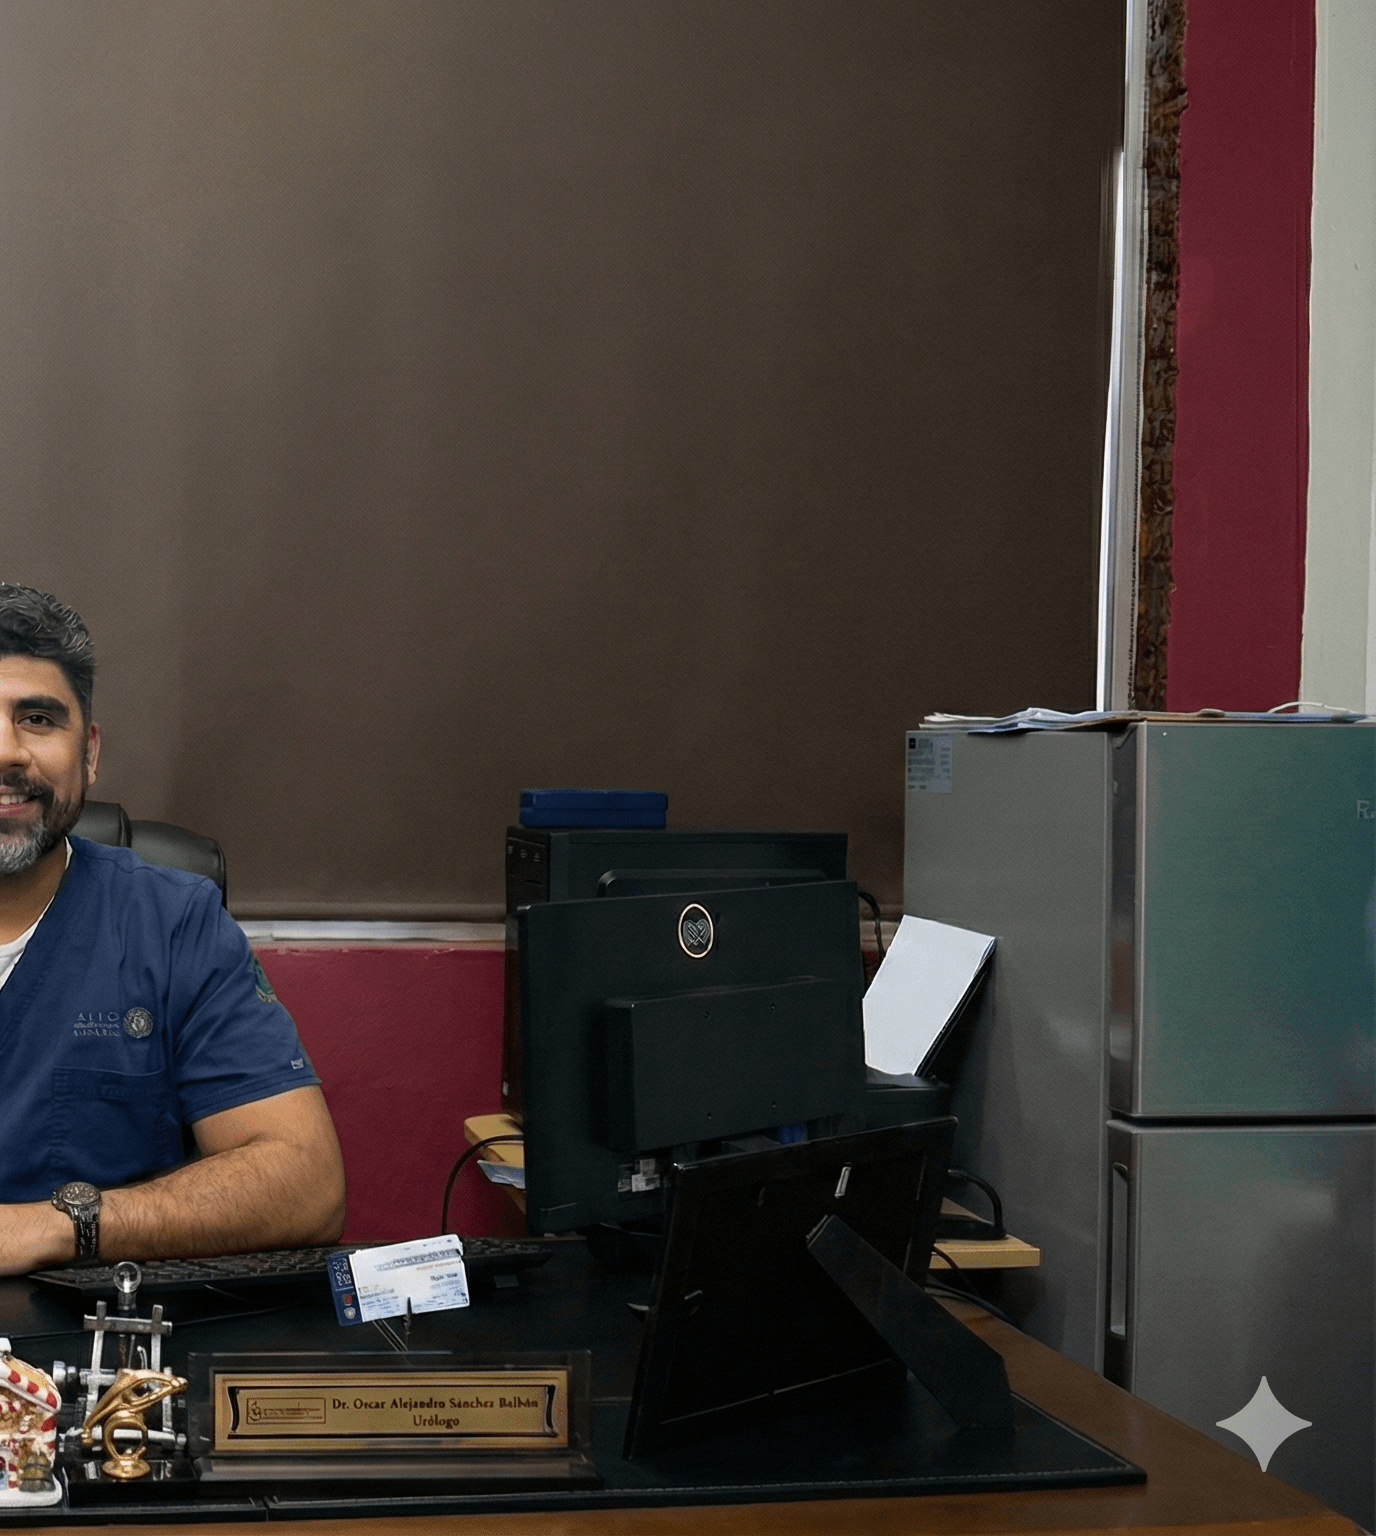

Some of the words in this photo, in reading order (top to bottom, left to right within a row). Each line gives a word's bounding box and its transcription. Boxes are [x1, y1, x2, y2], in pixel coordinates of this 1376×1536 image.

[332, 1398, 350, 1410] Dr.
[390, 1397, 446, 1412] Alejandro
[413, 1414, 460, 1430] Urólogo
